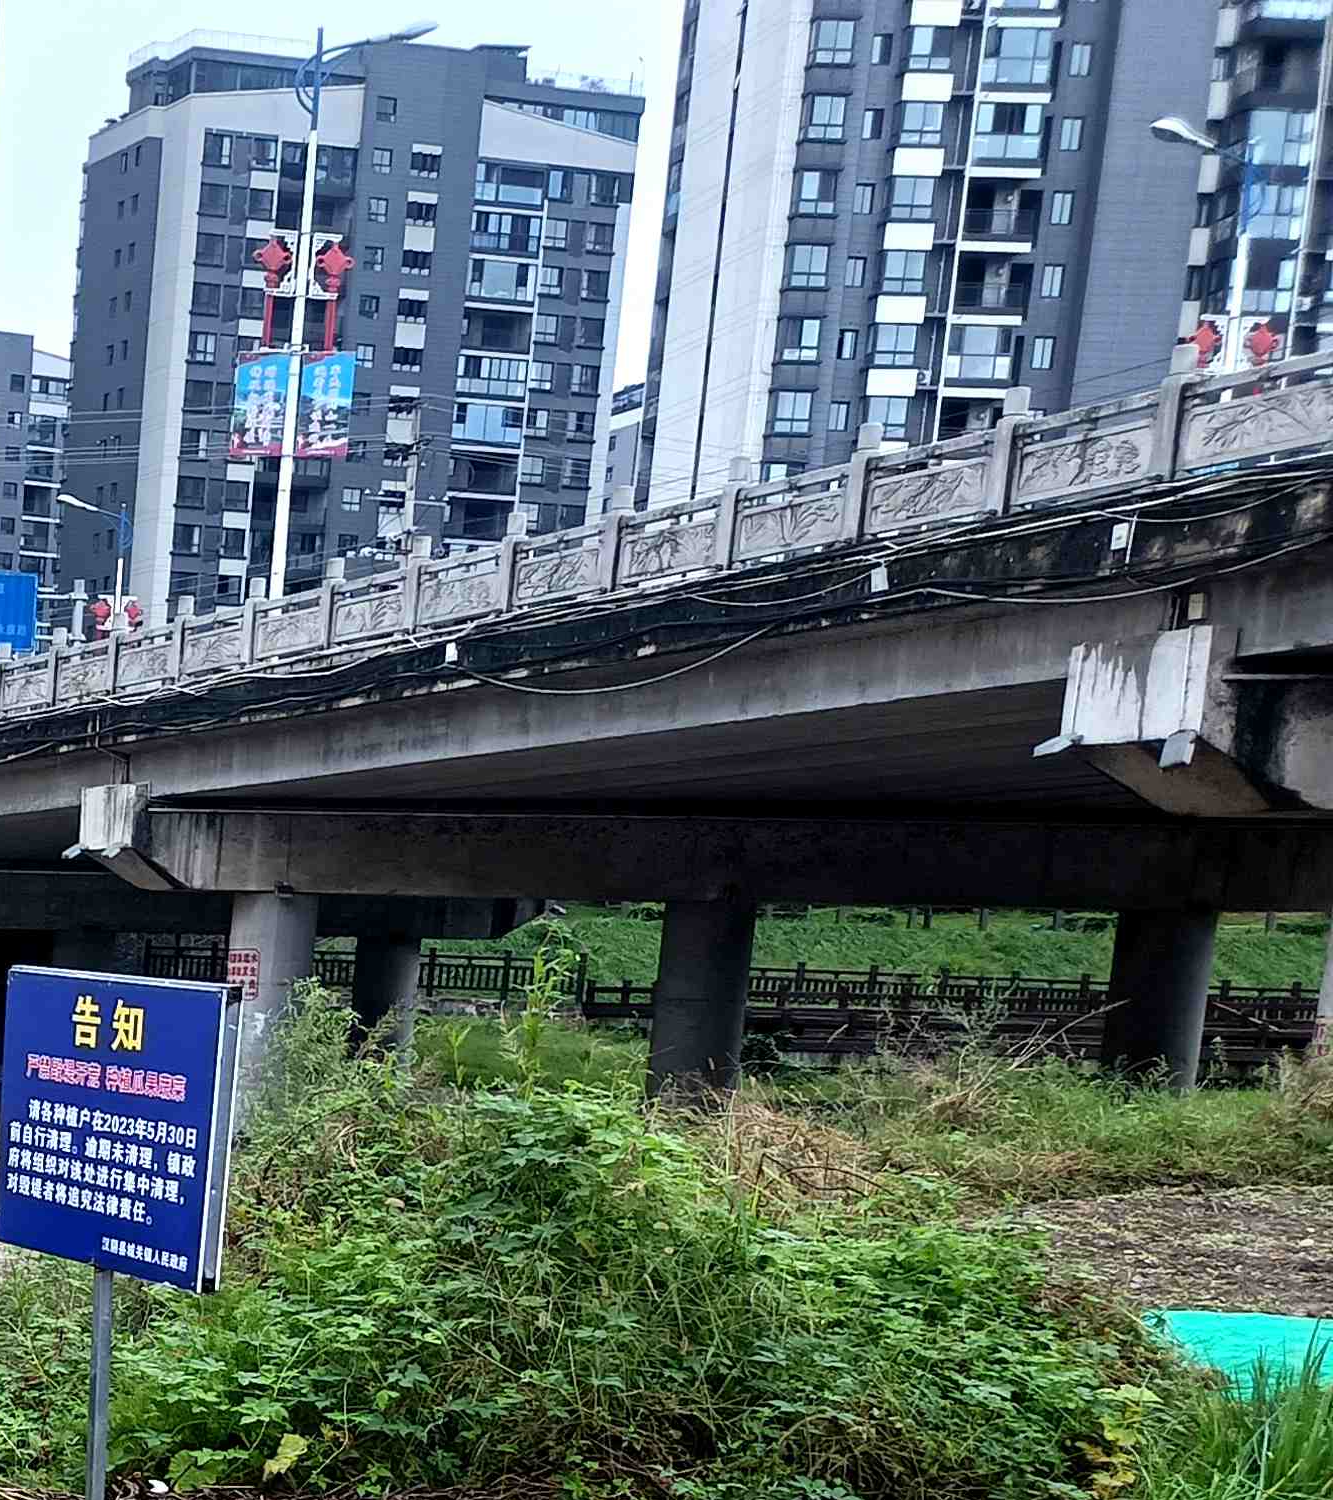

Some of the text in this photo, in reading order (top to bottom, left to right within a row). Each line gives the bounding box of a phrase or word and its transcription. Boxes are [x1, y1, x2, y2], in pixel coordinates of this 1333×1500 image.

[72, 995, 145, 1051] 告知
[28, 1099, 198, 1150] 请各种植户在2023年5月30日
